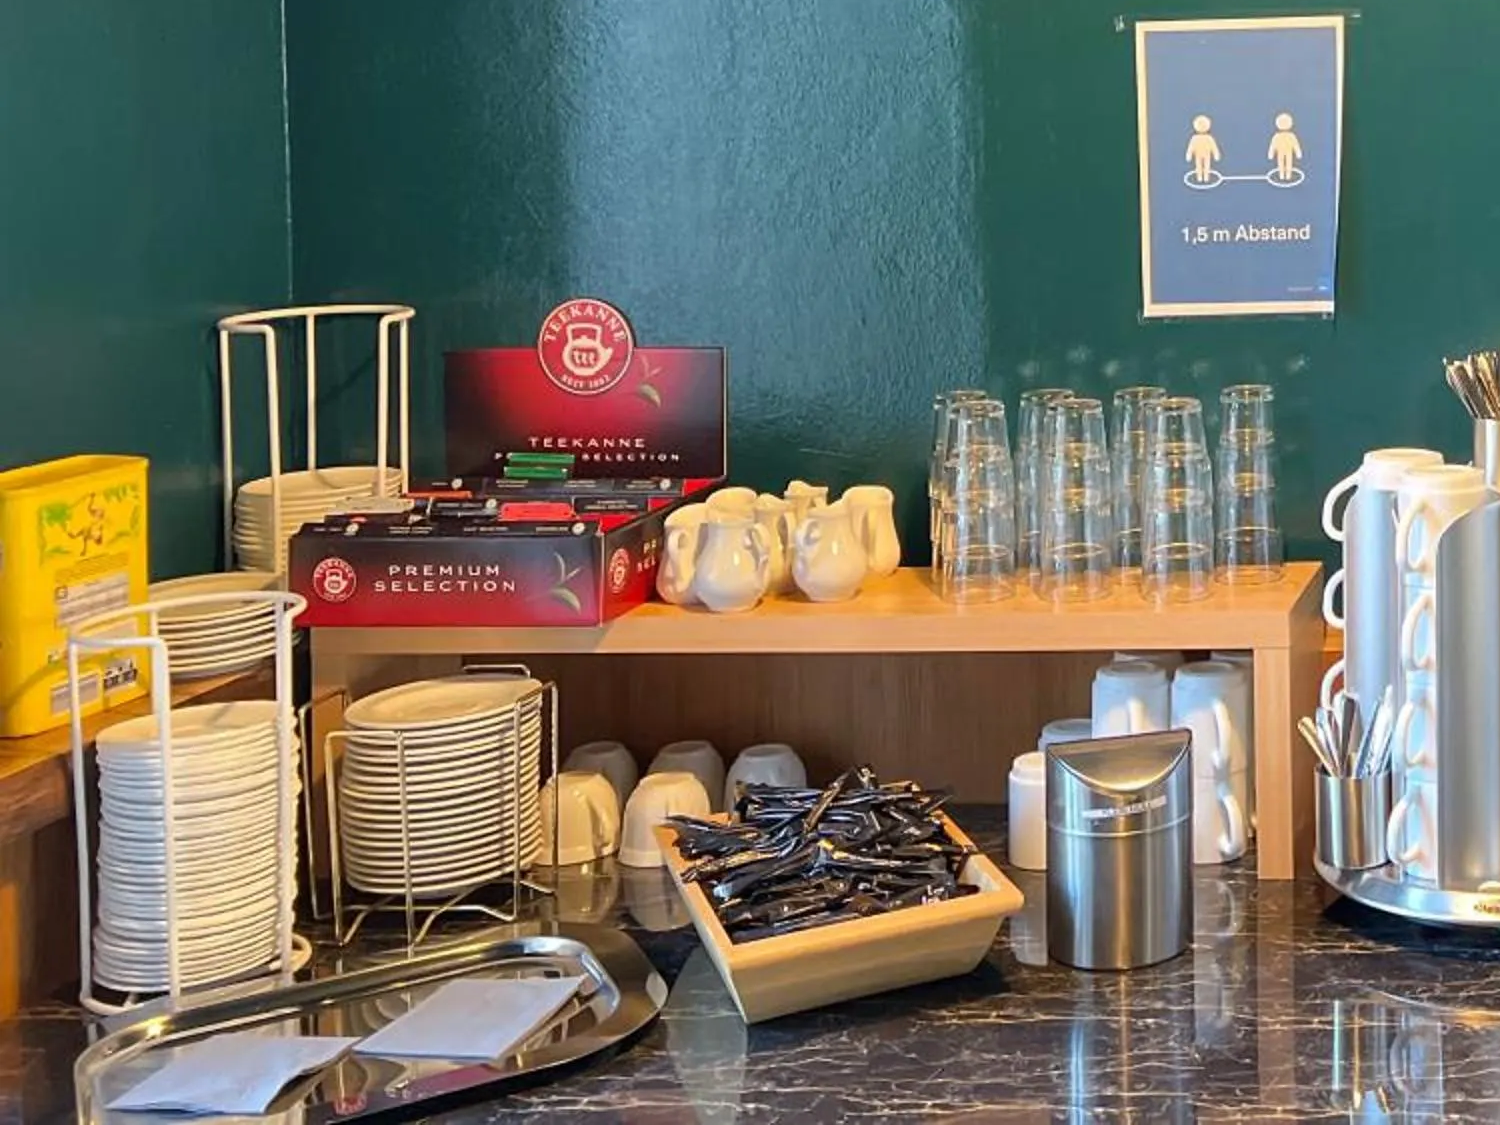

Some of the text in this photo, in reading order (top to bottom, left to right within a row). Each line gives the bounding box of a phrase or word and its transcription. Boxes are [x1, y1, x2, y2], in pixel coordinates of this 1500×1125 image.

[1181, 224, 1311, 245] 1,5 m Abstand
[543, 304, 627, 343] TEEKANNE
[528, 437, 645, 448] TEEKANNE
[581, 452, 680, 462] SELECTION
[388, 564, 500, 576] PREMIUM
[373, 579, 515, 592] SELECTION
